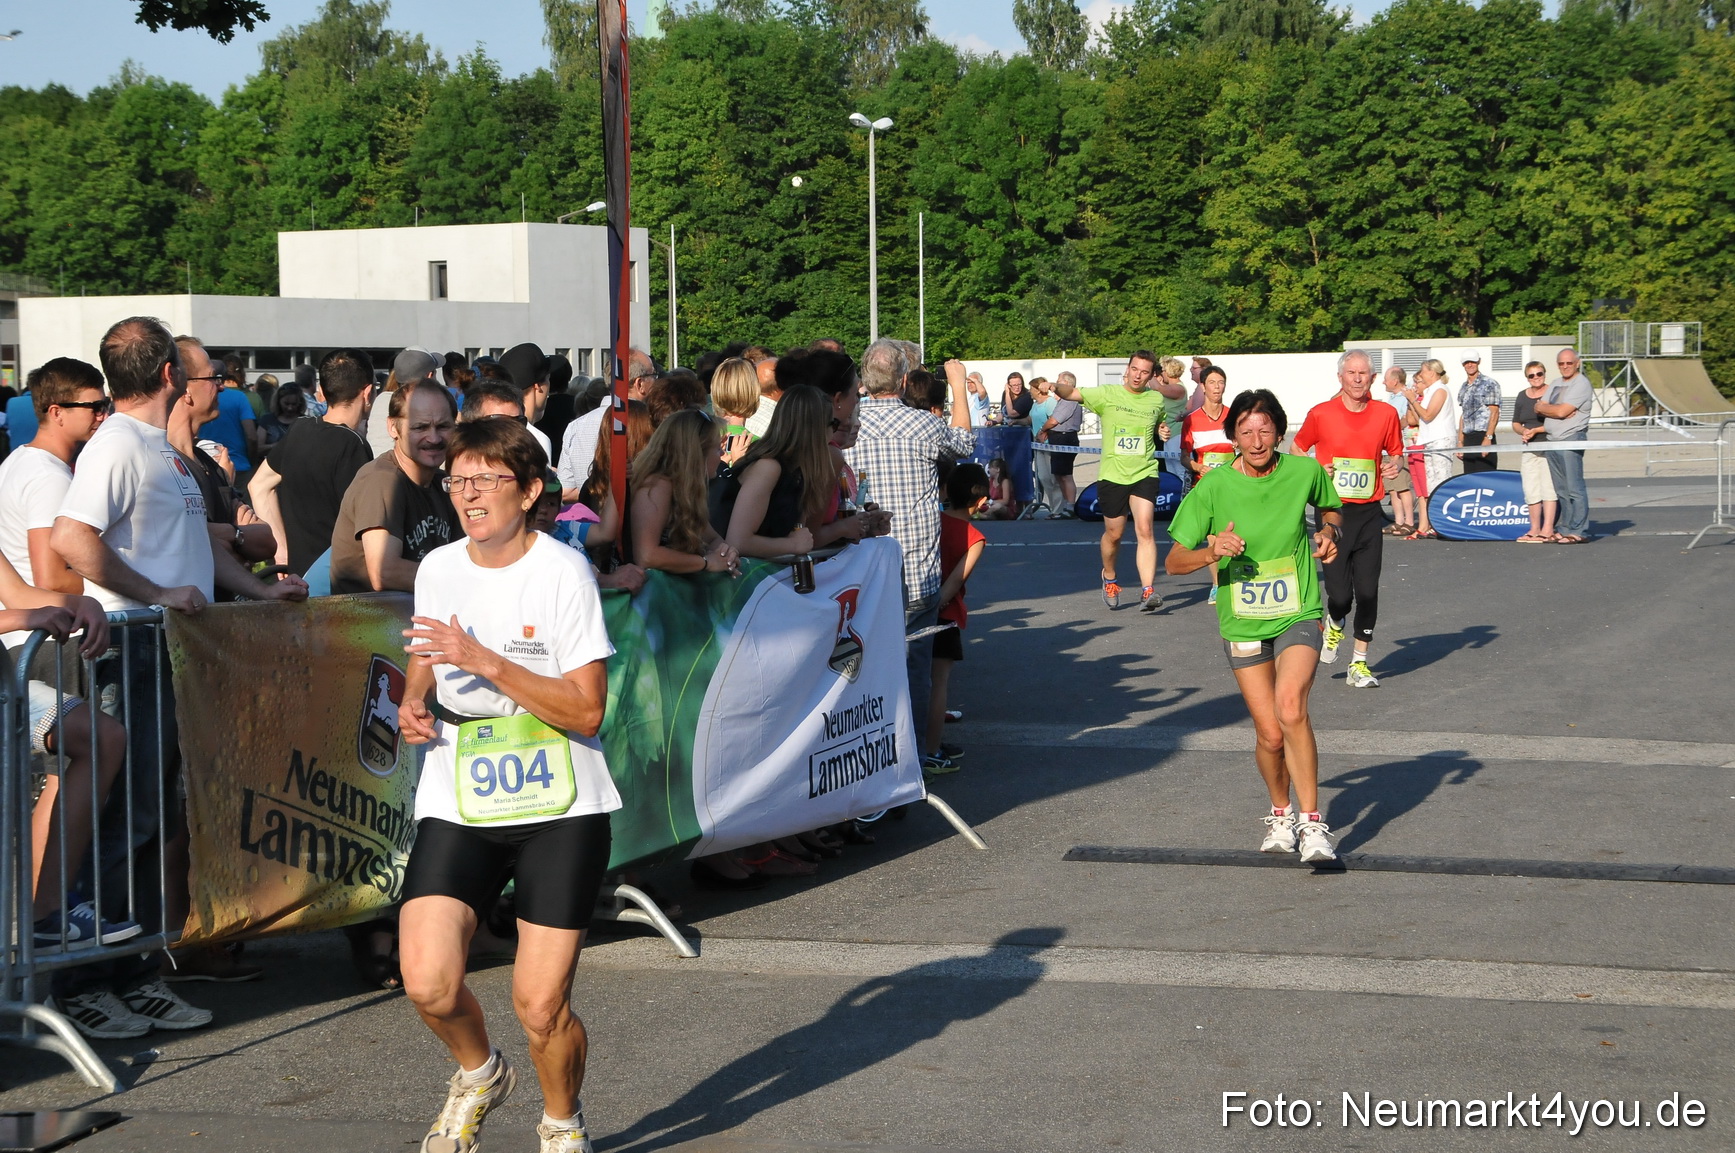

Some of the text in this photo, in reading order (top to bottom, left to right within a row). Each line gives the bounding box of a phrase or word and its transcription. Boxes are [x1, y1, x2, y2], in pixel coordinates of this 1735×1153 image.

[1117, 437, 1141, 450] 437
[1338, 471, 1369, 489] 500
[1155, 492, 1174, 506] er
[1240, 579, 1288, 605] 570
[503, 644, 549, 656] Lammsbräu
[511, 640, 545, 648] Neumarkter
[821, 693, 884, 743] Neumarkter
[365, 742, 387, 767] 1628
[808, 726, 899, 800] Lammsbräu
[470, 748, 555, 797] 904
[493, 793, 539, 804] Maria Schmidt
[478, 806, 512, 815] Neumarkter
[511, 802, 546, 812] Lammsbräu
